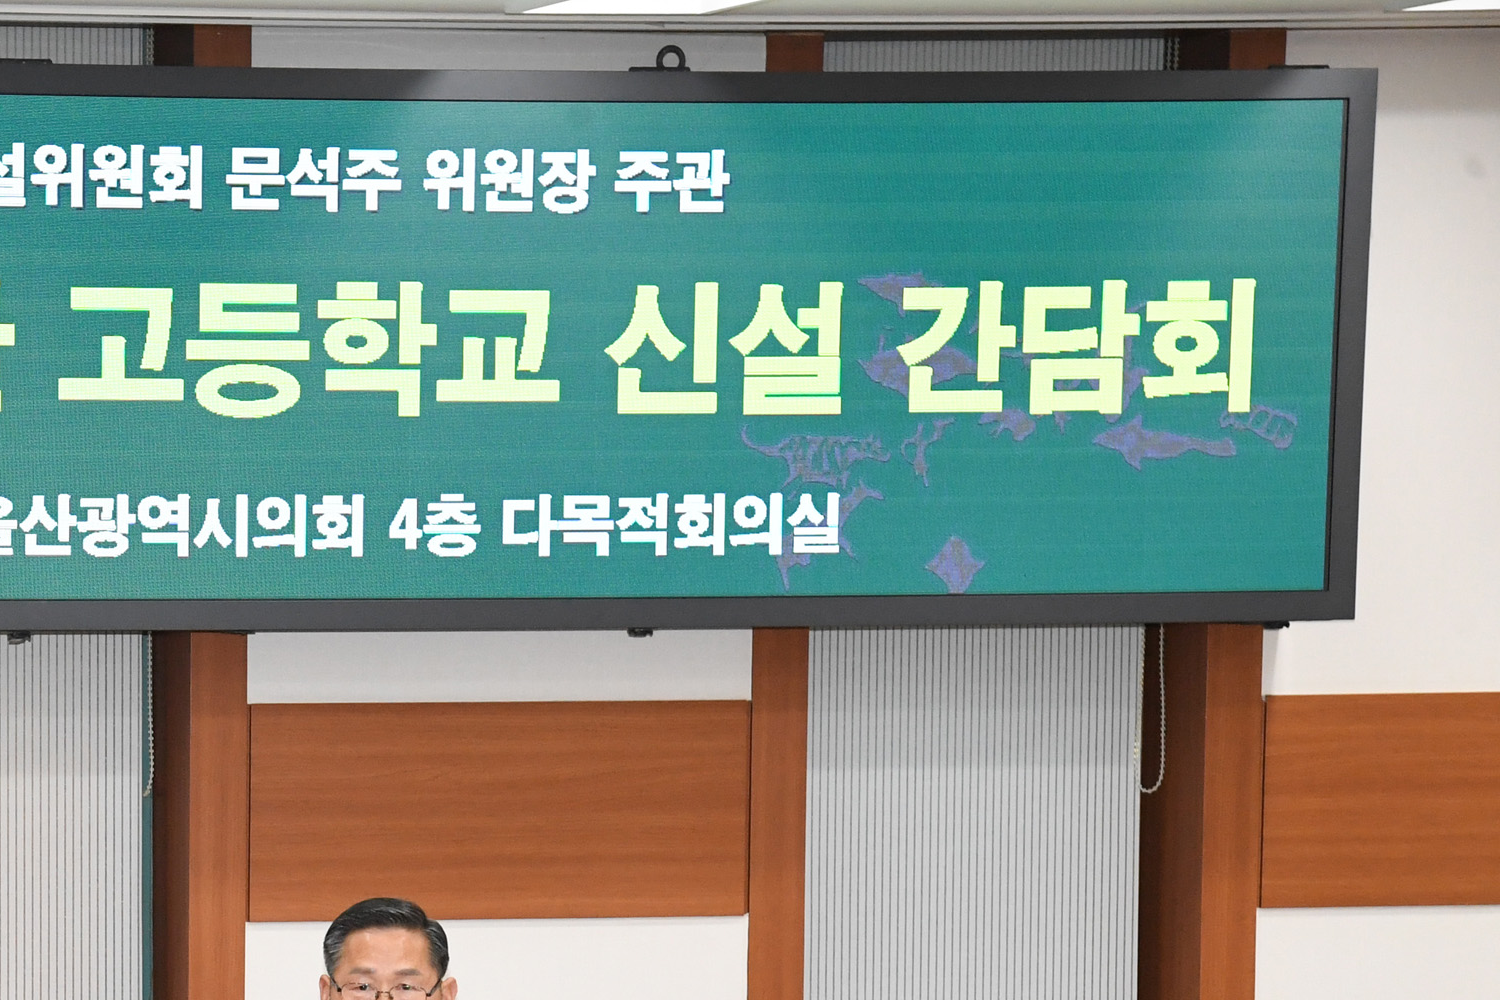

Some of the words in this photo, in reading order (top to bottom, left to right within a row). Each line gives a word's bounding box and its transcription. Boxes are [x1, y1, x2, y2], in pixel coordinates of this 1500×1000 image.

[226, 147, 402, 213] 문석주
[424, 149, 597, 214] 위원장
[615, 150, 731, 213] 주관
[58, 282, 560, 419] 고등학교
[604, 282, 844, 415] 신설
[897, 278, 1257, 415] 간담회
[390, 493, 482, 557] 4층
[502, 493, 841, 557] 다목적회의실
